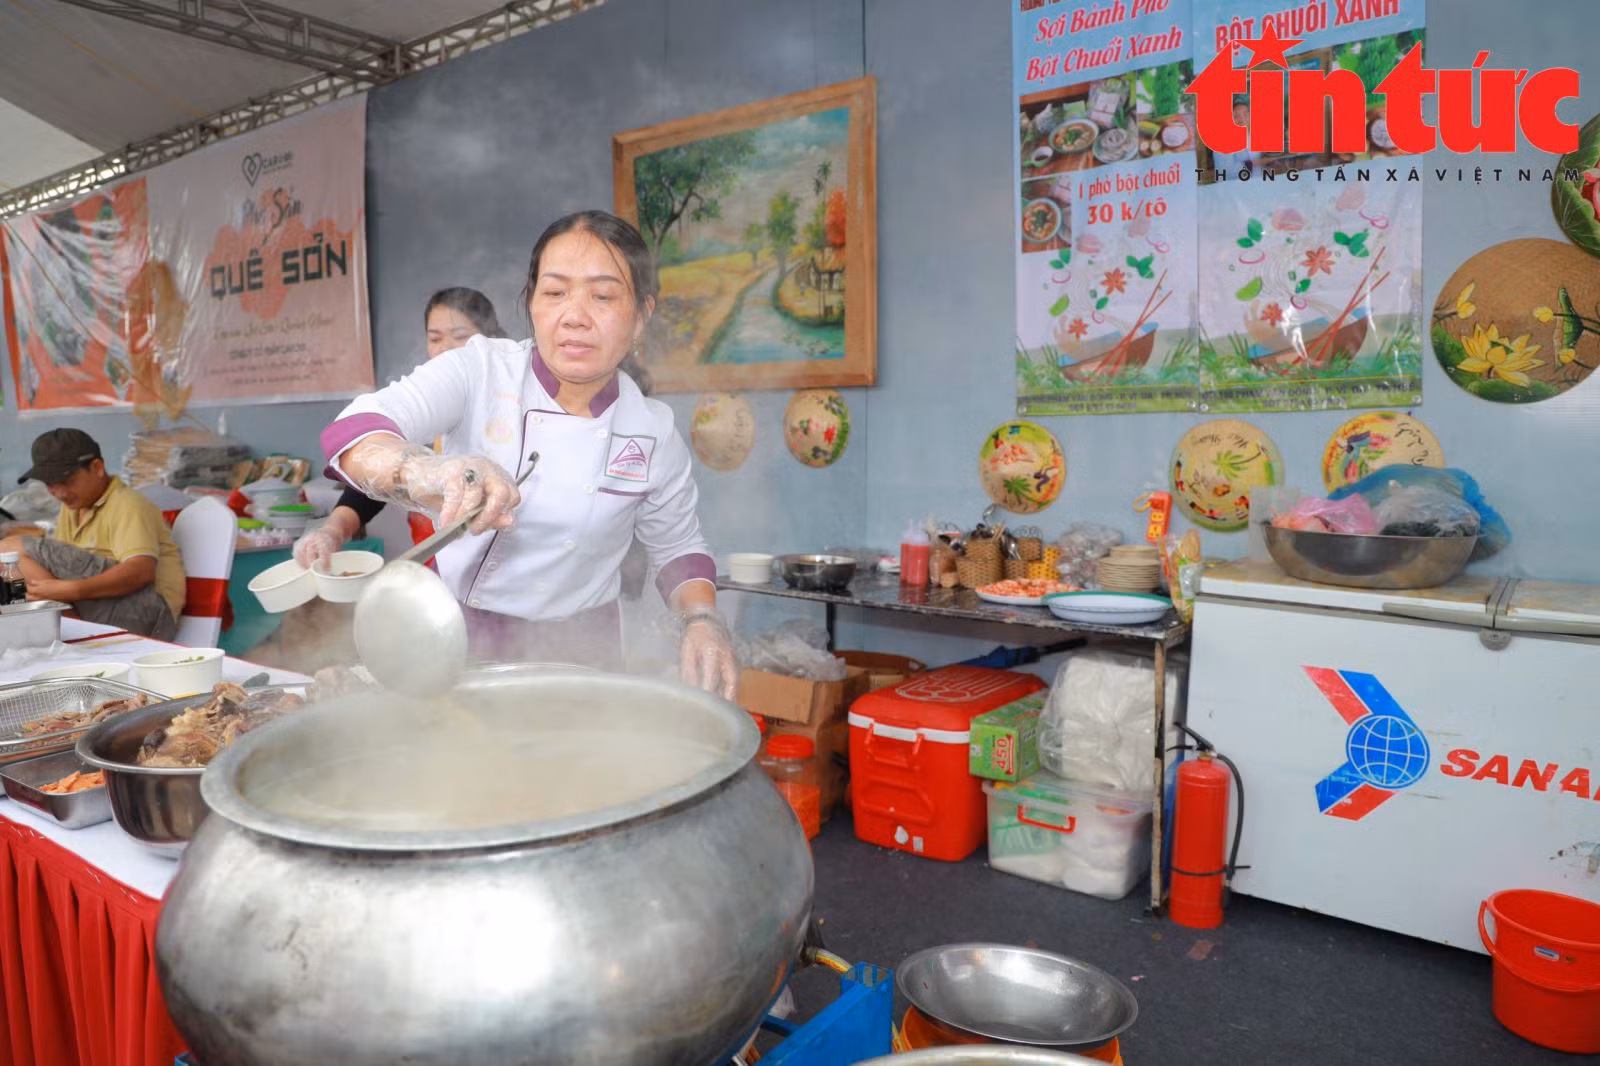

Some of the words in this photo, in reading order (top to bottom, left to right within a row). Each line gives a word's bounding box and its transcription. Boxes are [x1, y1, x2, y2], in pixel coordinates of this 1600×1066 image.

[1026, 55, 1060, 85] Bột
[1063, 36, 1123, 73] Chuối
[1125, 25, 1183, 61] Xanh
[1116, 173, 1140, 196] bột
[1143, 163, 1181, 188] chuối
[1088, 203, 1114, 225] 30
[1440, 749, 1600, 802] SANA
